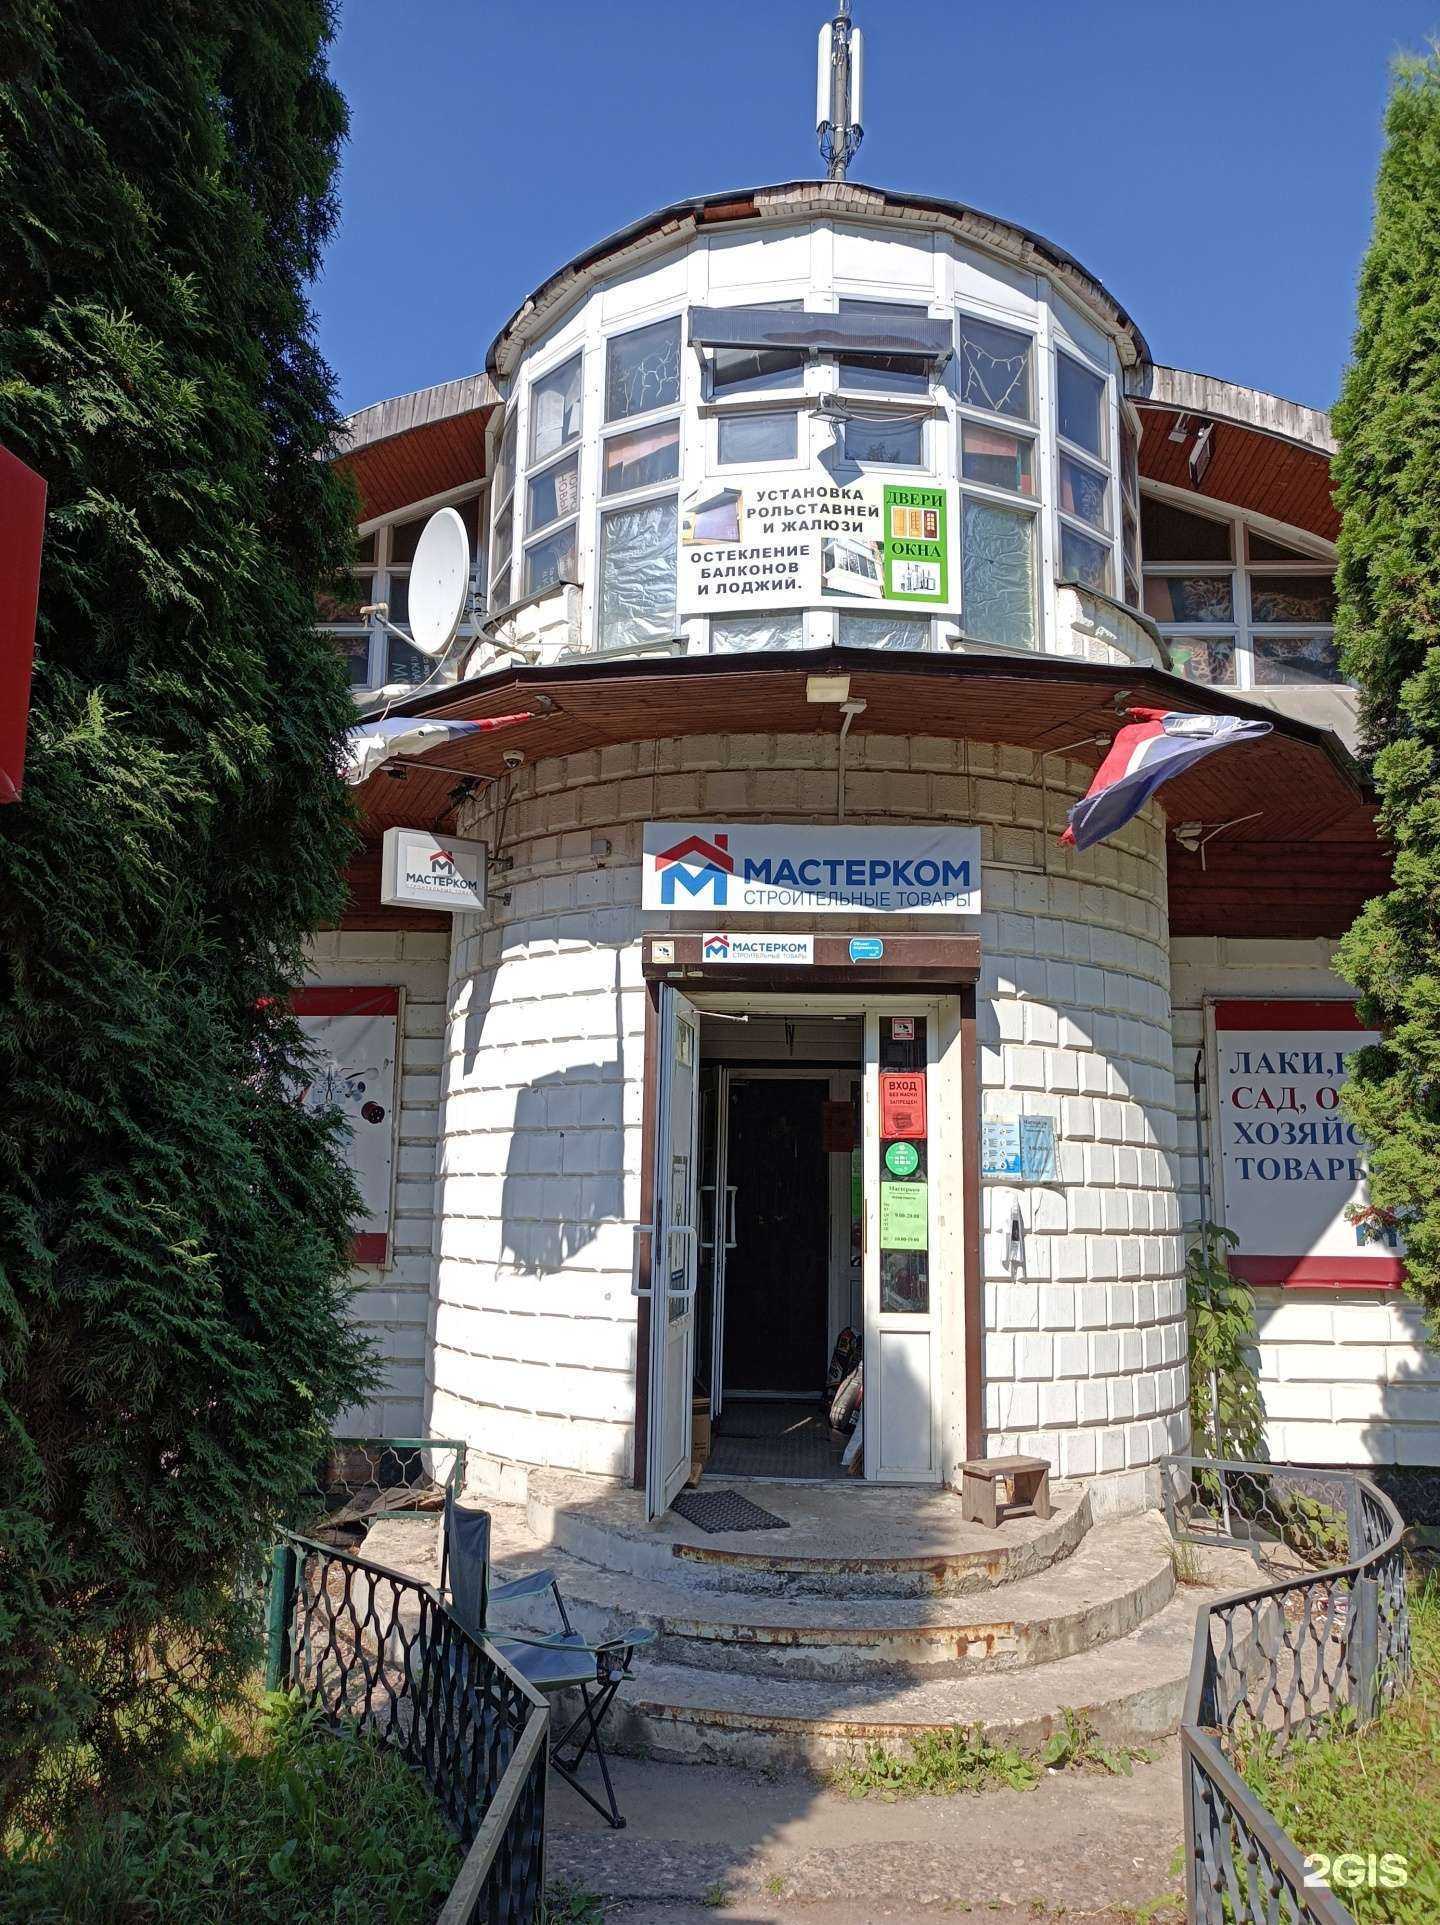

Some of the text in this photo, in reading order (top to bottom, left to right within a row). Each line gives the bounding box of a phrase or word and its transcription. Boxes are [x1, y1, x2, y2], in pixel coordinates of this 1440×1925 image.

[757, 486, 864, 502] УСТАНОВКА
[886, 491, 944, 508] ДВЕРИ
[747, 503, 880, 519] РОЛЬСТАВНЕЙ
[763, 520, 864, 534] И ЖАЛЮЗИ
[690, 544, 811, 563] ОСТЕКЛЕНИЕ
[891, 542, 942, 558] ОКНА
[700, 562, 799, 579] БАЛКОНОВ
[698, 577, 803, 596] И ЛОДЖИЙ.
[406, 872, 477, 890] МАСТЕРКОМ
[744, 858, 971, 887] МАСТЕРКОМ
[744, 890, 971, 908] СТРОИТЕЛЬНЫЕ ТОВАРЫ
[732, 942, 807, 953] МАСТЕРКОМ
[888, 1081, 917, 1091] ВХОД
[1231, 1086, 1306, 1115] САД,
[1233, 1116, 1365, 1146] ХОЗЯЙС
